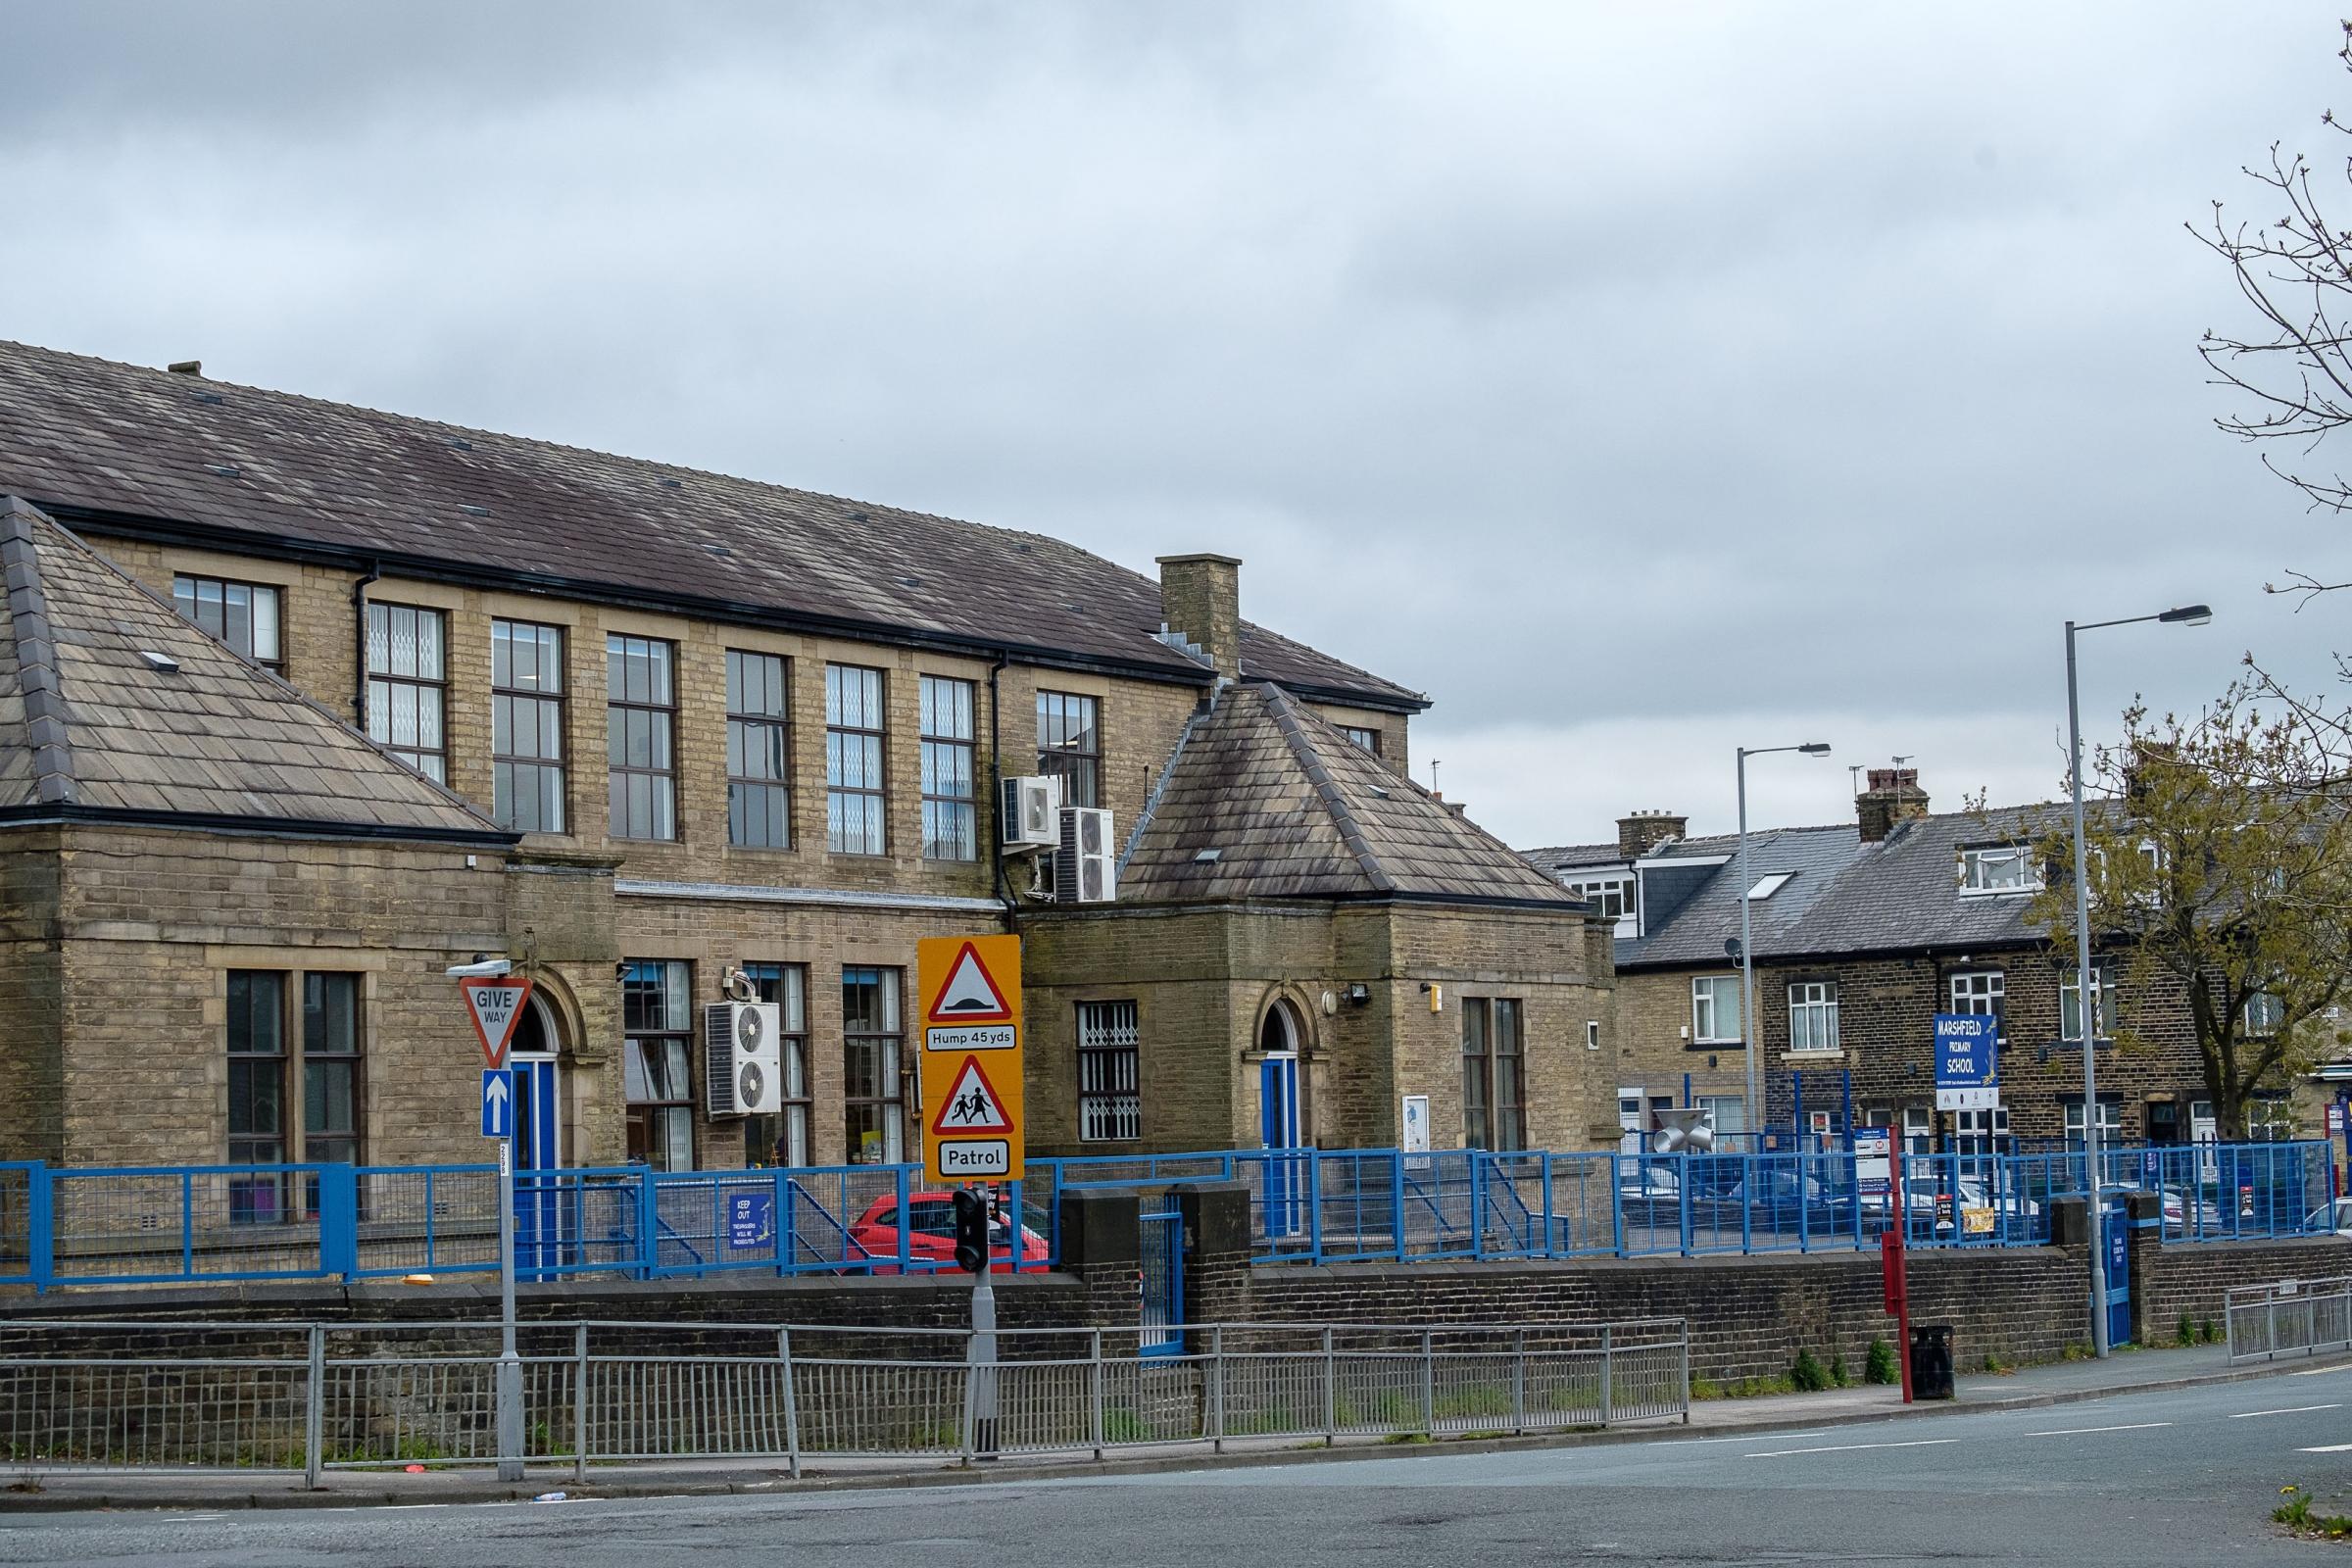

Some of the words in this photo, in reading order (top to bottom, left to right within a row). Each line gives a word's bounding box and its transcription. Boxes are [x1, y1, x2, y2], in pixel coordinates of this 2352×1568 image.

[476, 991, 513, 1008] GIVE
[484, 1011, 508, 1023] WAY
[1937, 1020, 1982, 1036] MARSHFIELD
[933, 1033, 967, 1046] Hump
[971, 1032, 988, 1043] 45
[990, 1031, 1010, 1045] yds
[1949, 1041, 1972, 1054] PRIMARY
[1946, 1058, 1975, 1074] SCHOOL
[948, 1149, 1002, 1166] Patrol
[737, 1200, 751, 1209] KEEP
[737, 1210, 751, 1219] OUT
